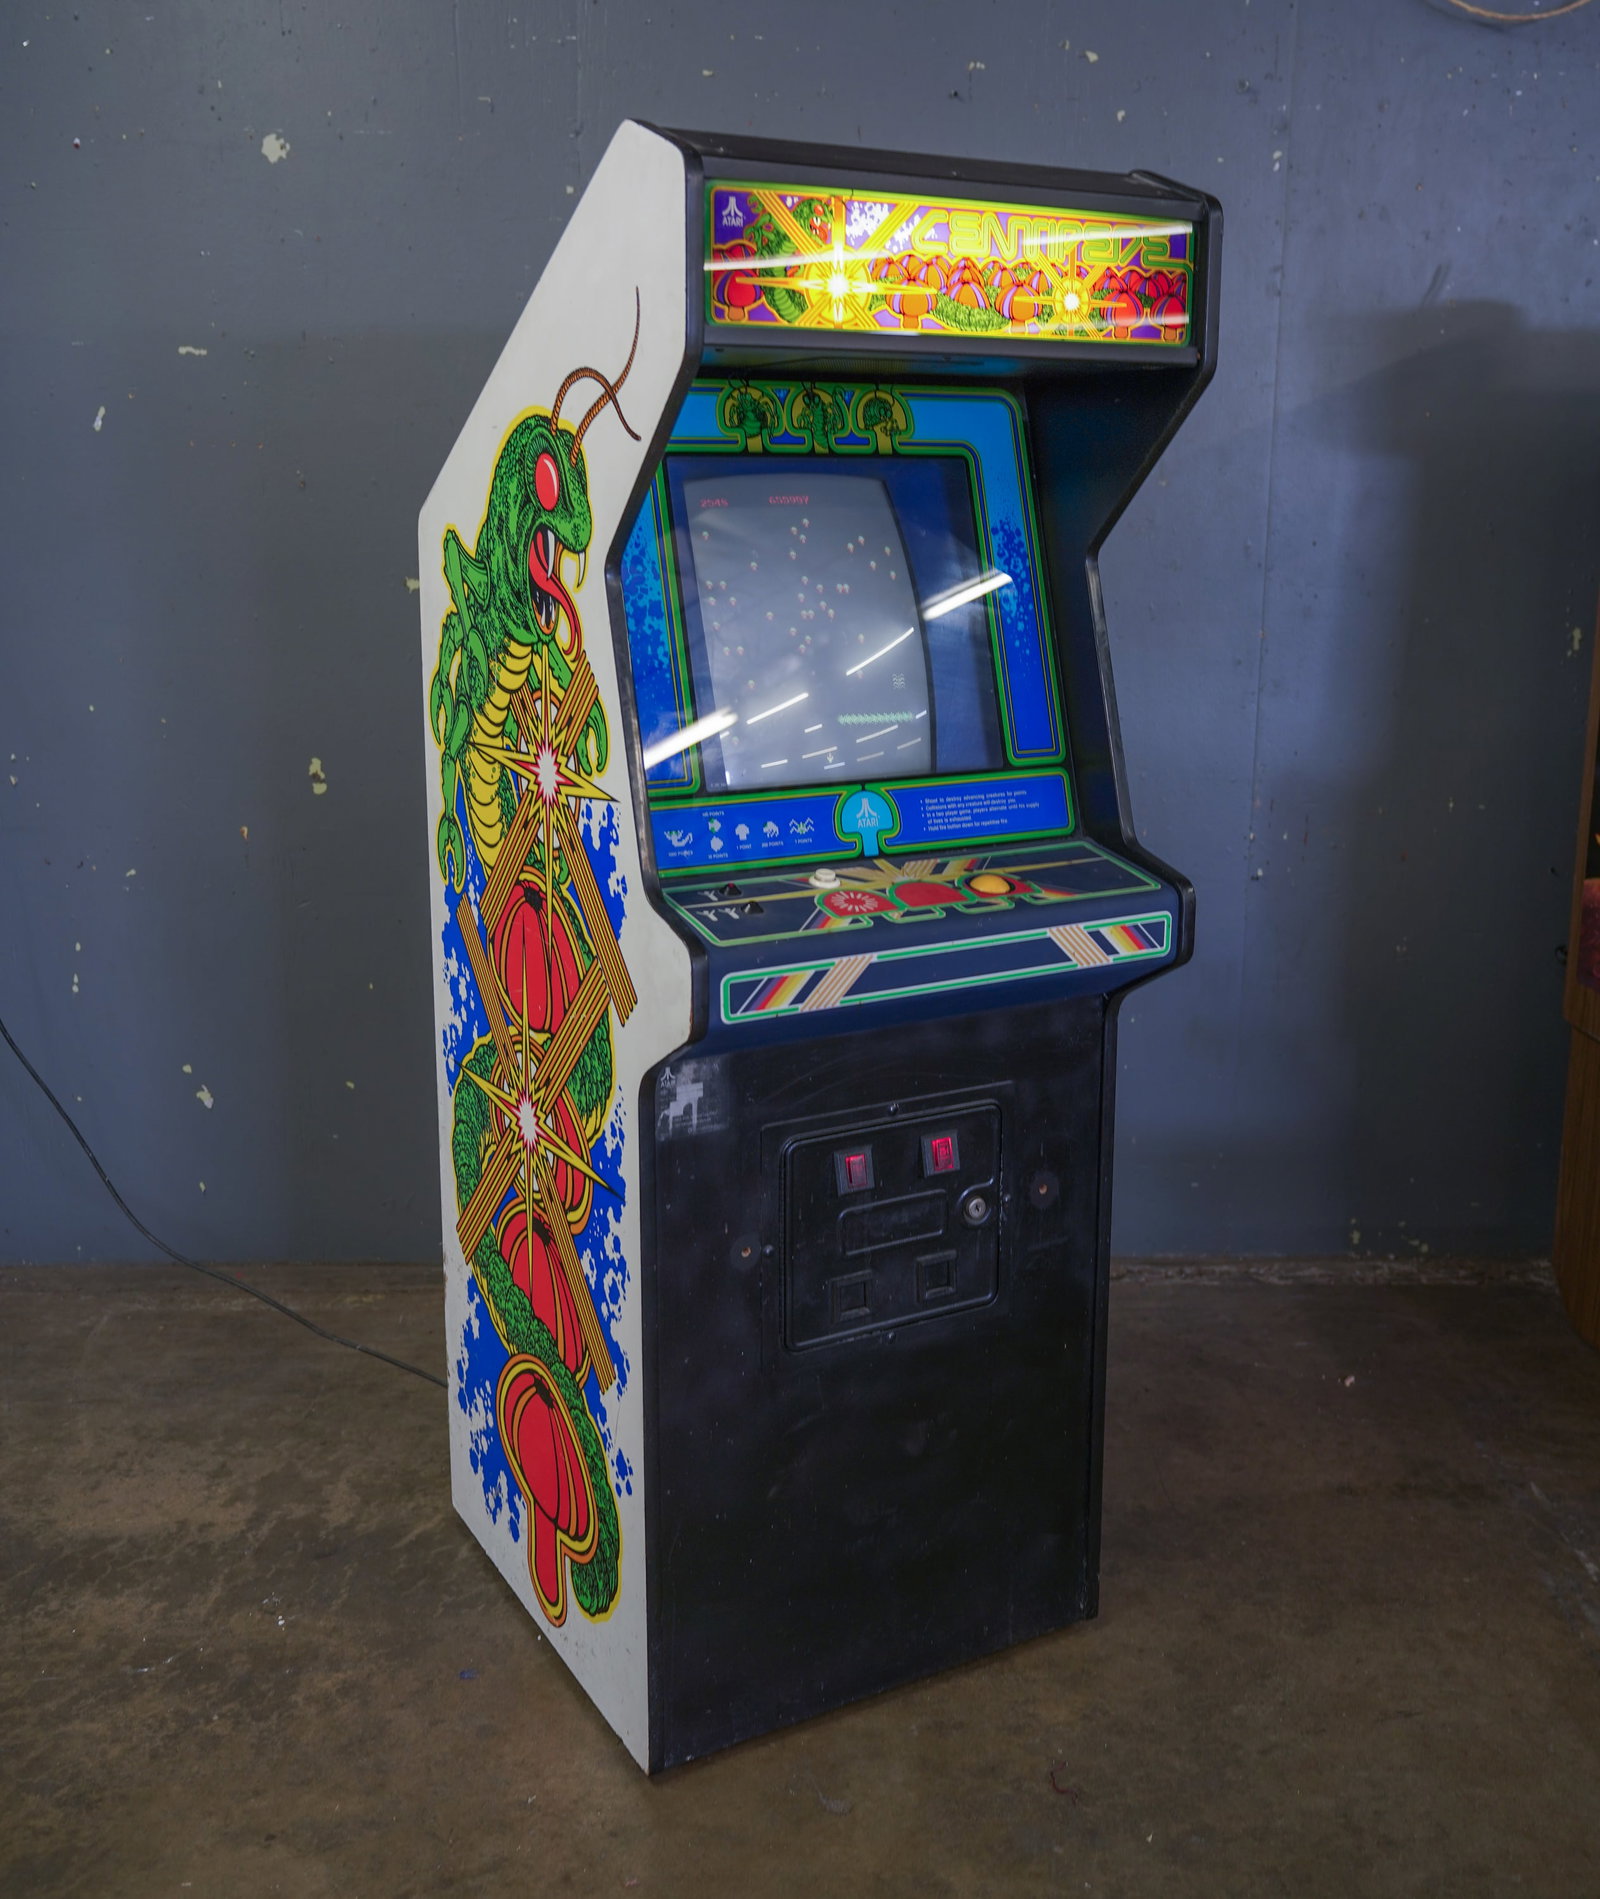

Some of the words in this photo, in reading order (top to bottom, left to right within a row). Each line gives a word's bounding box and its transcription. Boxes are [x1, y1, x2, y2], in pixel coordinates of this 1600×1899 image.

[722, 216, 744, 228] ATARI
[911, 210, 1174, 269] CENTIPEDE
[857, 817, 879, 829] ATARI
